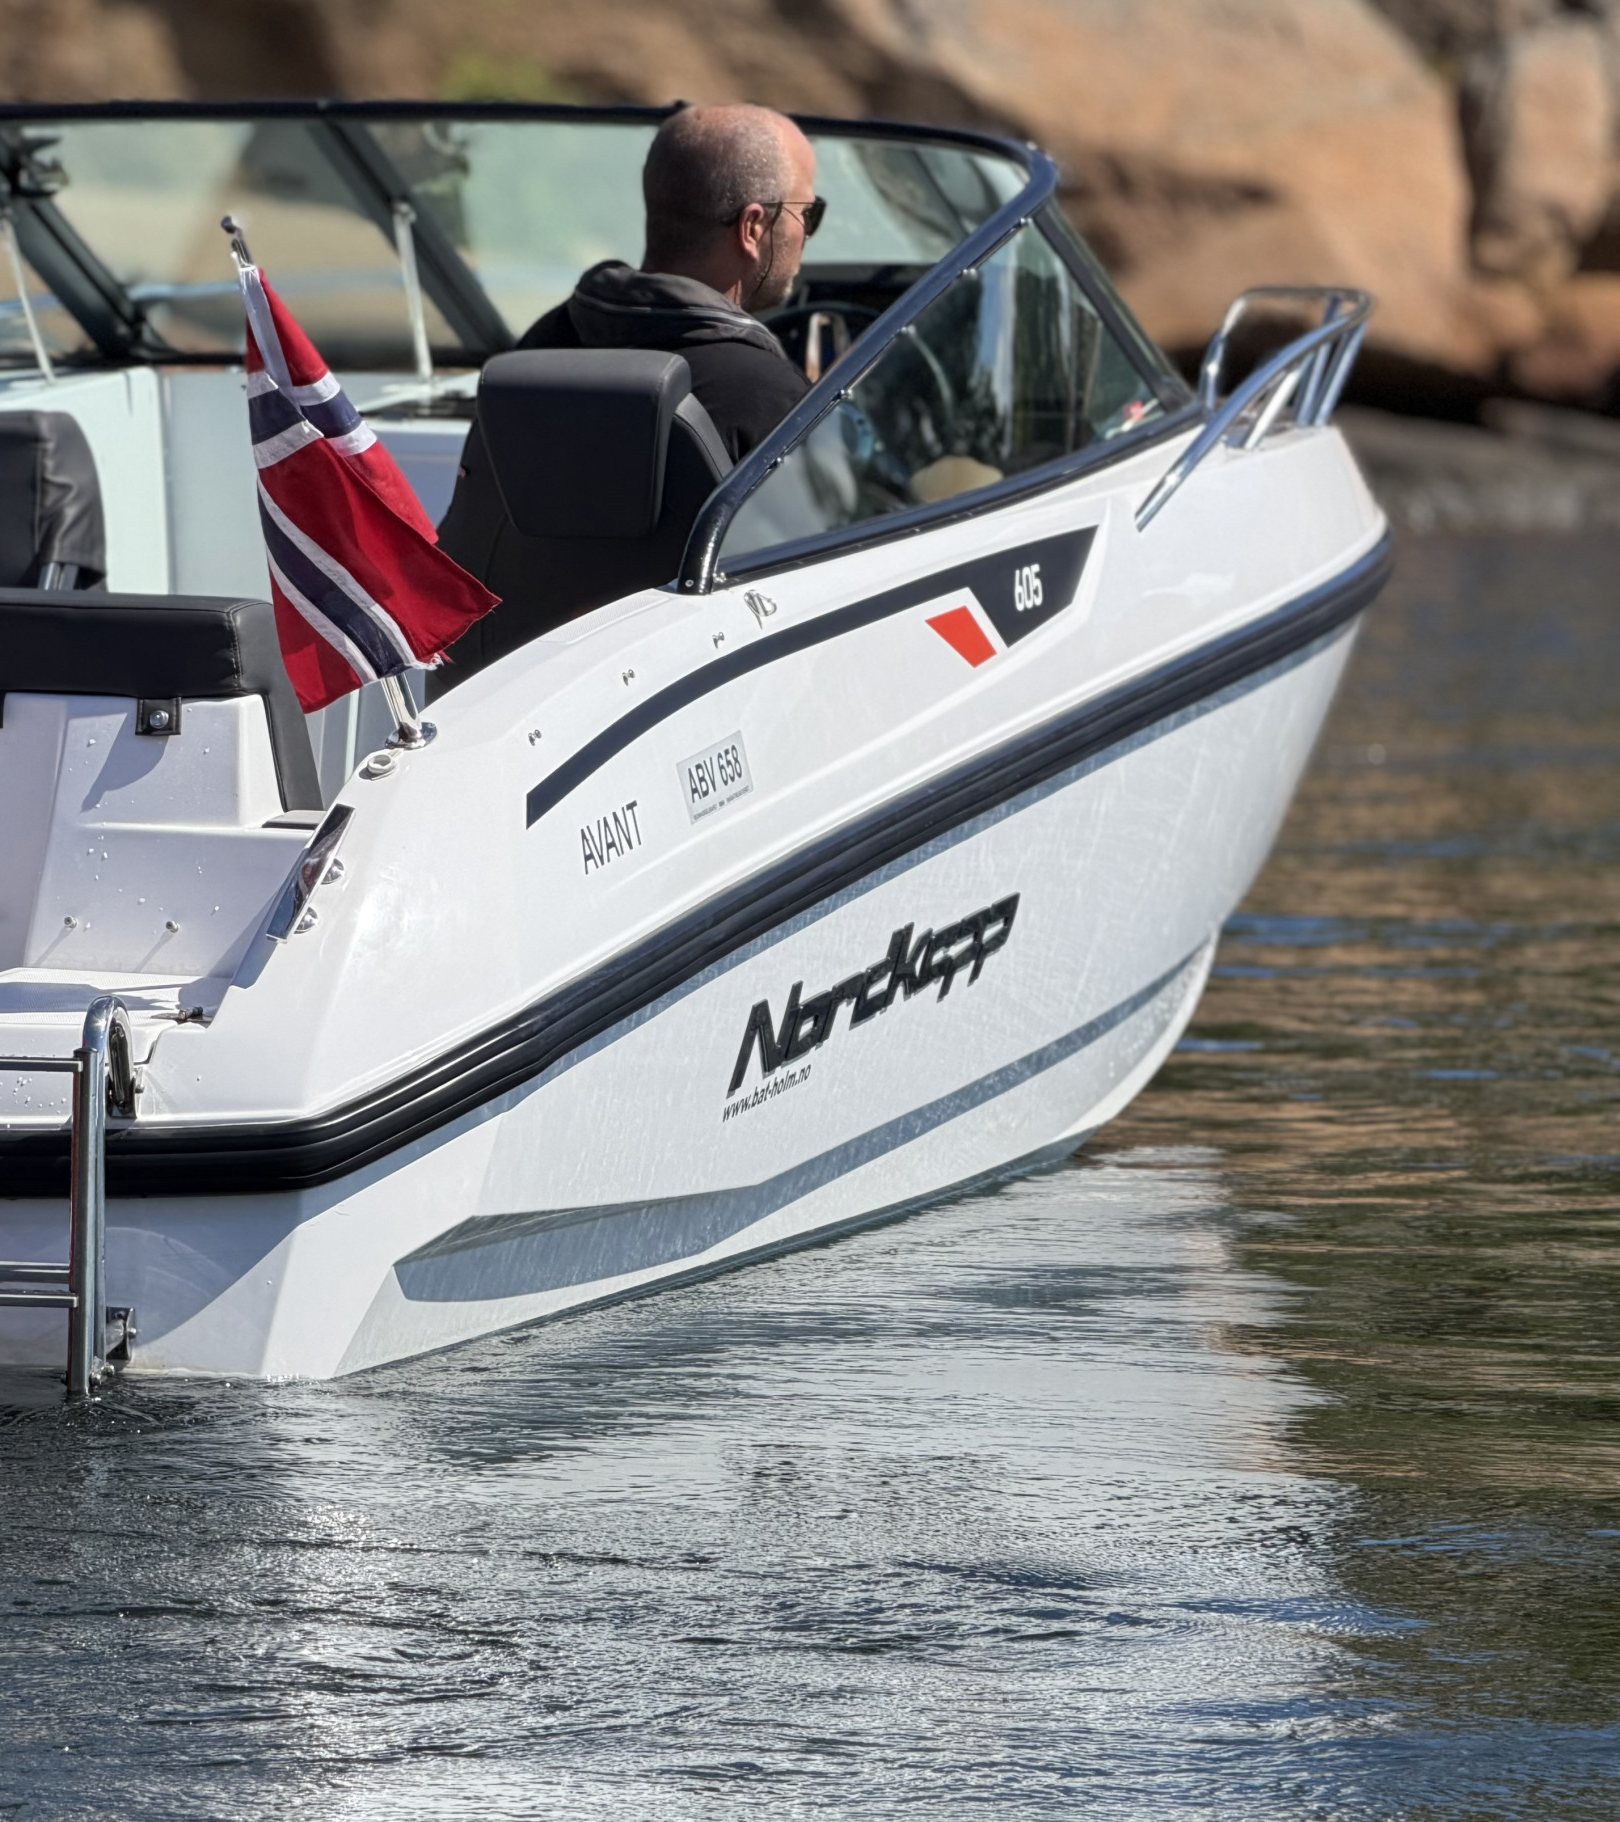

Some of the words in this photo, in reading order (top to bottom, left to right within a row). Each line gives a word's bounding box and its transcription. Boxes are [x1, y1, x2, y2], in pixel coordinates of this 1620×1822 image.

[1014, 563, 1043, 612] 605
[687, 756, 717, 804] ABV
[717, 744, 743, 787] 658
[580, 799, 642, 875] AVANT
[726, 891, 1021, 1100] Nordkapp
